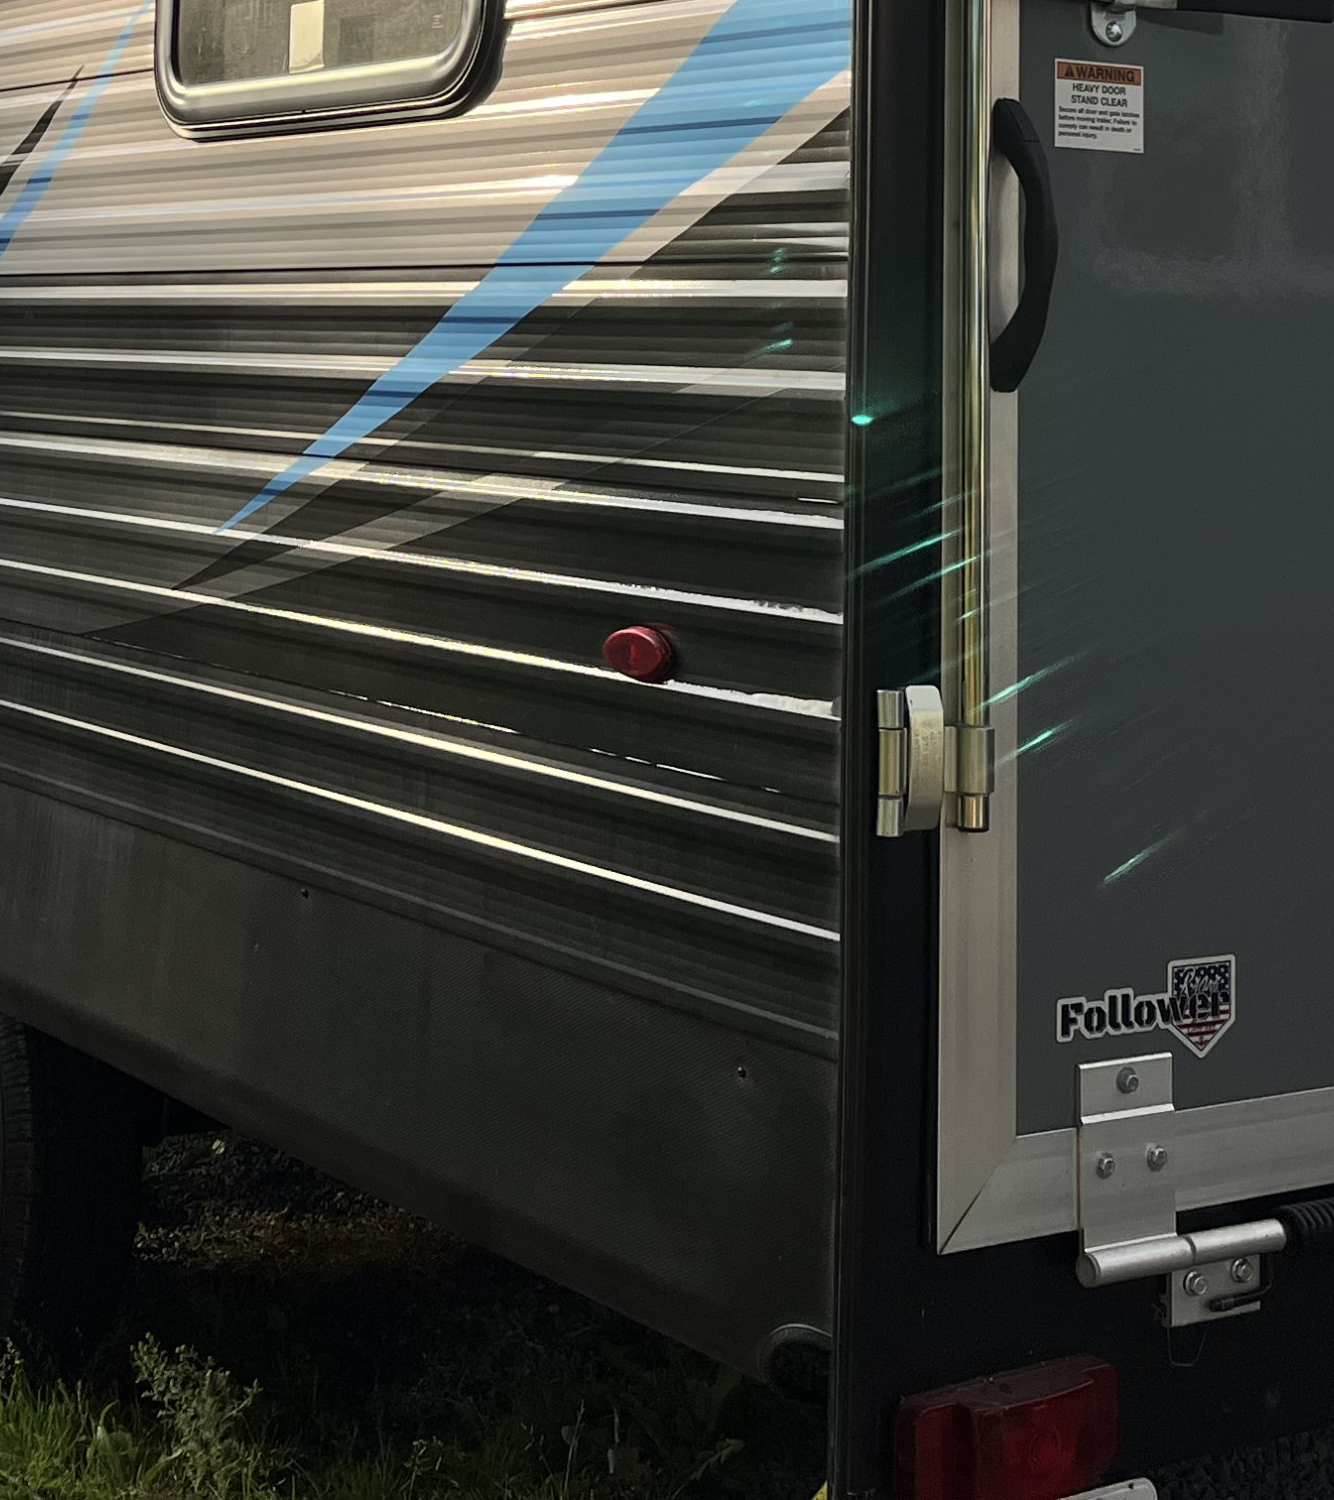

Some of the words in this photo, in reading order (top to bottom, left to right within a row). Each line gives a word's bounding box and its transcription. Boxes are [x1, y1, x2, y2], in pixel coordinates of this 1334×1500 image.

[1076, 66, 1135, 82] WARNING
[1072, 84, 1099, 93] HEAVY
[1102, 86, 1126, 95] DOOR
[1071, 95, 1098, 105] STAND
[1100, 98, 1128, 107] CLEAR
[1061, 990, 1230, 1038] Follower
